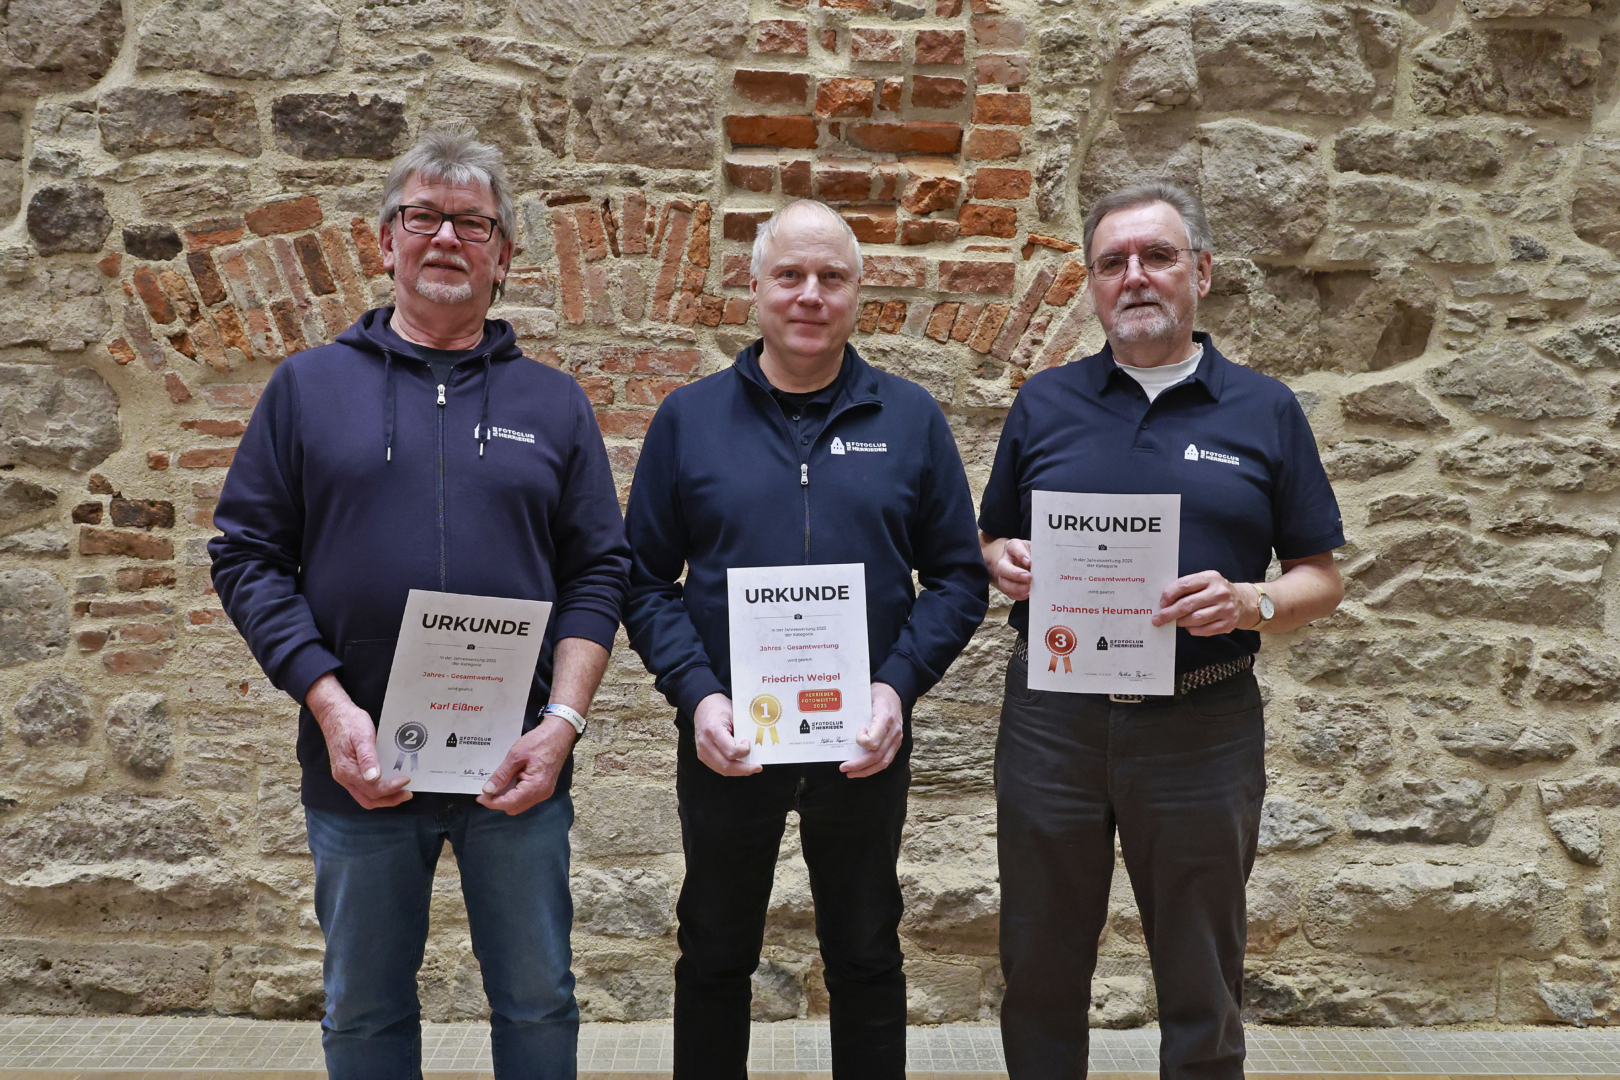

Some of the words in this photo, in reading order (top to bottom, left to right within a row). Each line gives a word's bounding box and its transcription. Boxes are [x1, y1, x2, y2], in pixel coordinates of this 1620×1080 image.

[498, 427, 535, 439] FOTOCLUB
[1205, 450, 1240, 462] FOTOCLUB
[1048, 513, 1162, 533] URKUNDE
[745, 585, 850, 604] URKUNDE
[1050, 604, 1100, 614] Johannes
[1102, 606, 1153, 614] Heumann
[422, 613, 531, 636] URKUNDE
[786, 642, 840, 650] Gesamtwertung
[1054, 633, 1067, 648] 3
[450, 673, 504, 682] Gesamtwertung
[762, 674, 804, 684] Friedrich
[806, 672, 840, 682] Weigel
[452, 704, 484, 712] Eißner
[760, 702, 771, 718] 1
[404, 730, 418, 744] 2
